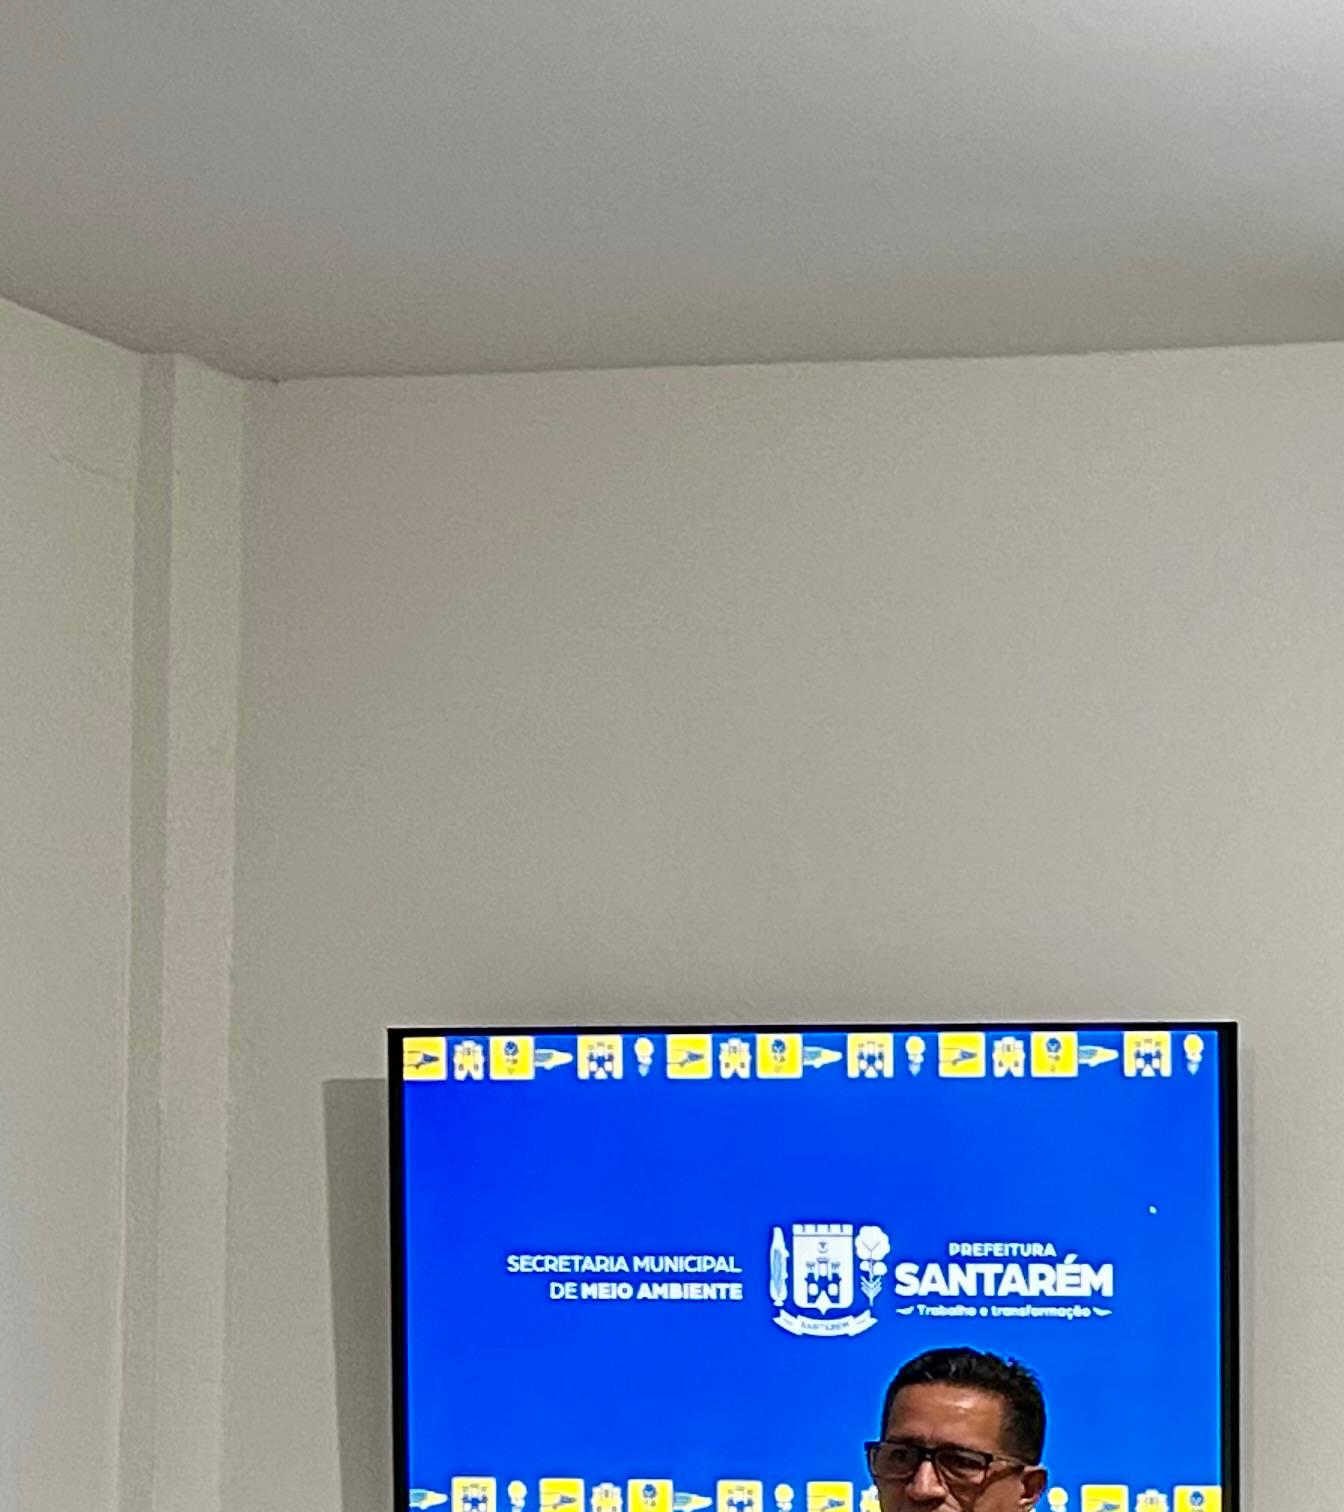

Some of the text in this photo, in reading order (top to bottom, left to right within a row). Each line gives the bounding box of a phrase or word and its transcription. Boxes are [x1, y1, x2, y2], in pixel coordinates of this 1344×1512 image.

[948, 1242, 1057, 1257] PREFEITURA
[507, 1254, 743, 1273] SECRETARIA MUNICIPAL
[894, 1253, 1114, 1297] SANTARÉM
[549, 1281, 743, 1300] DE MEIO AMBIENTE
